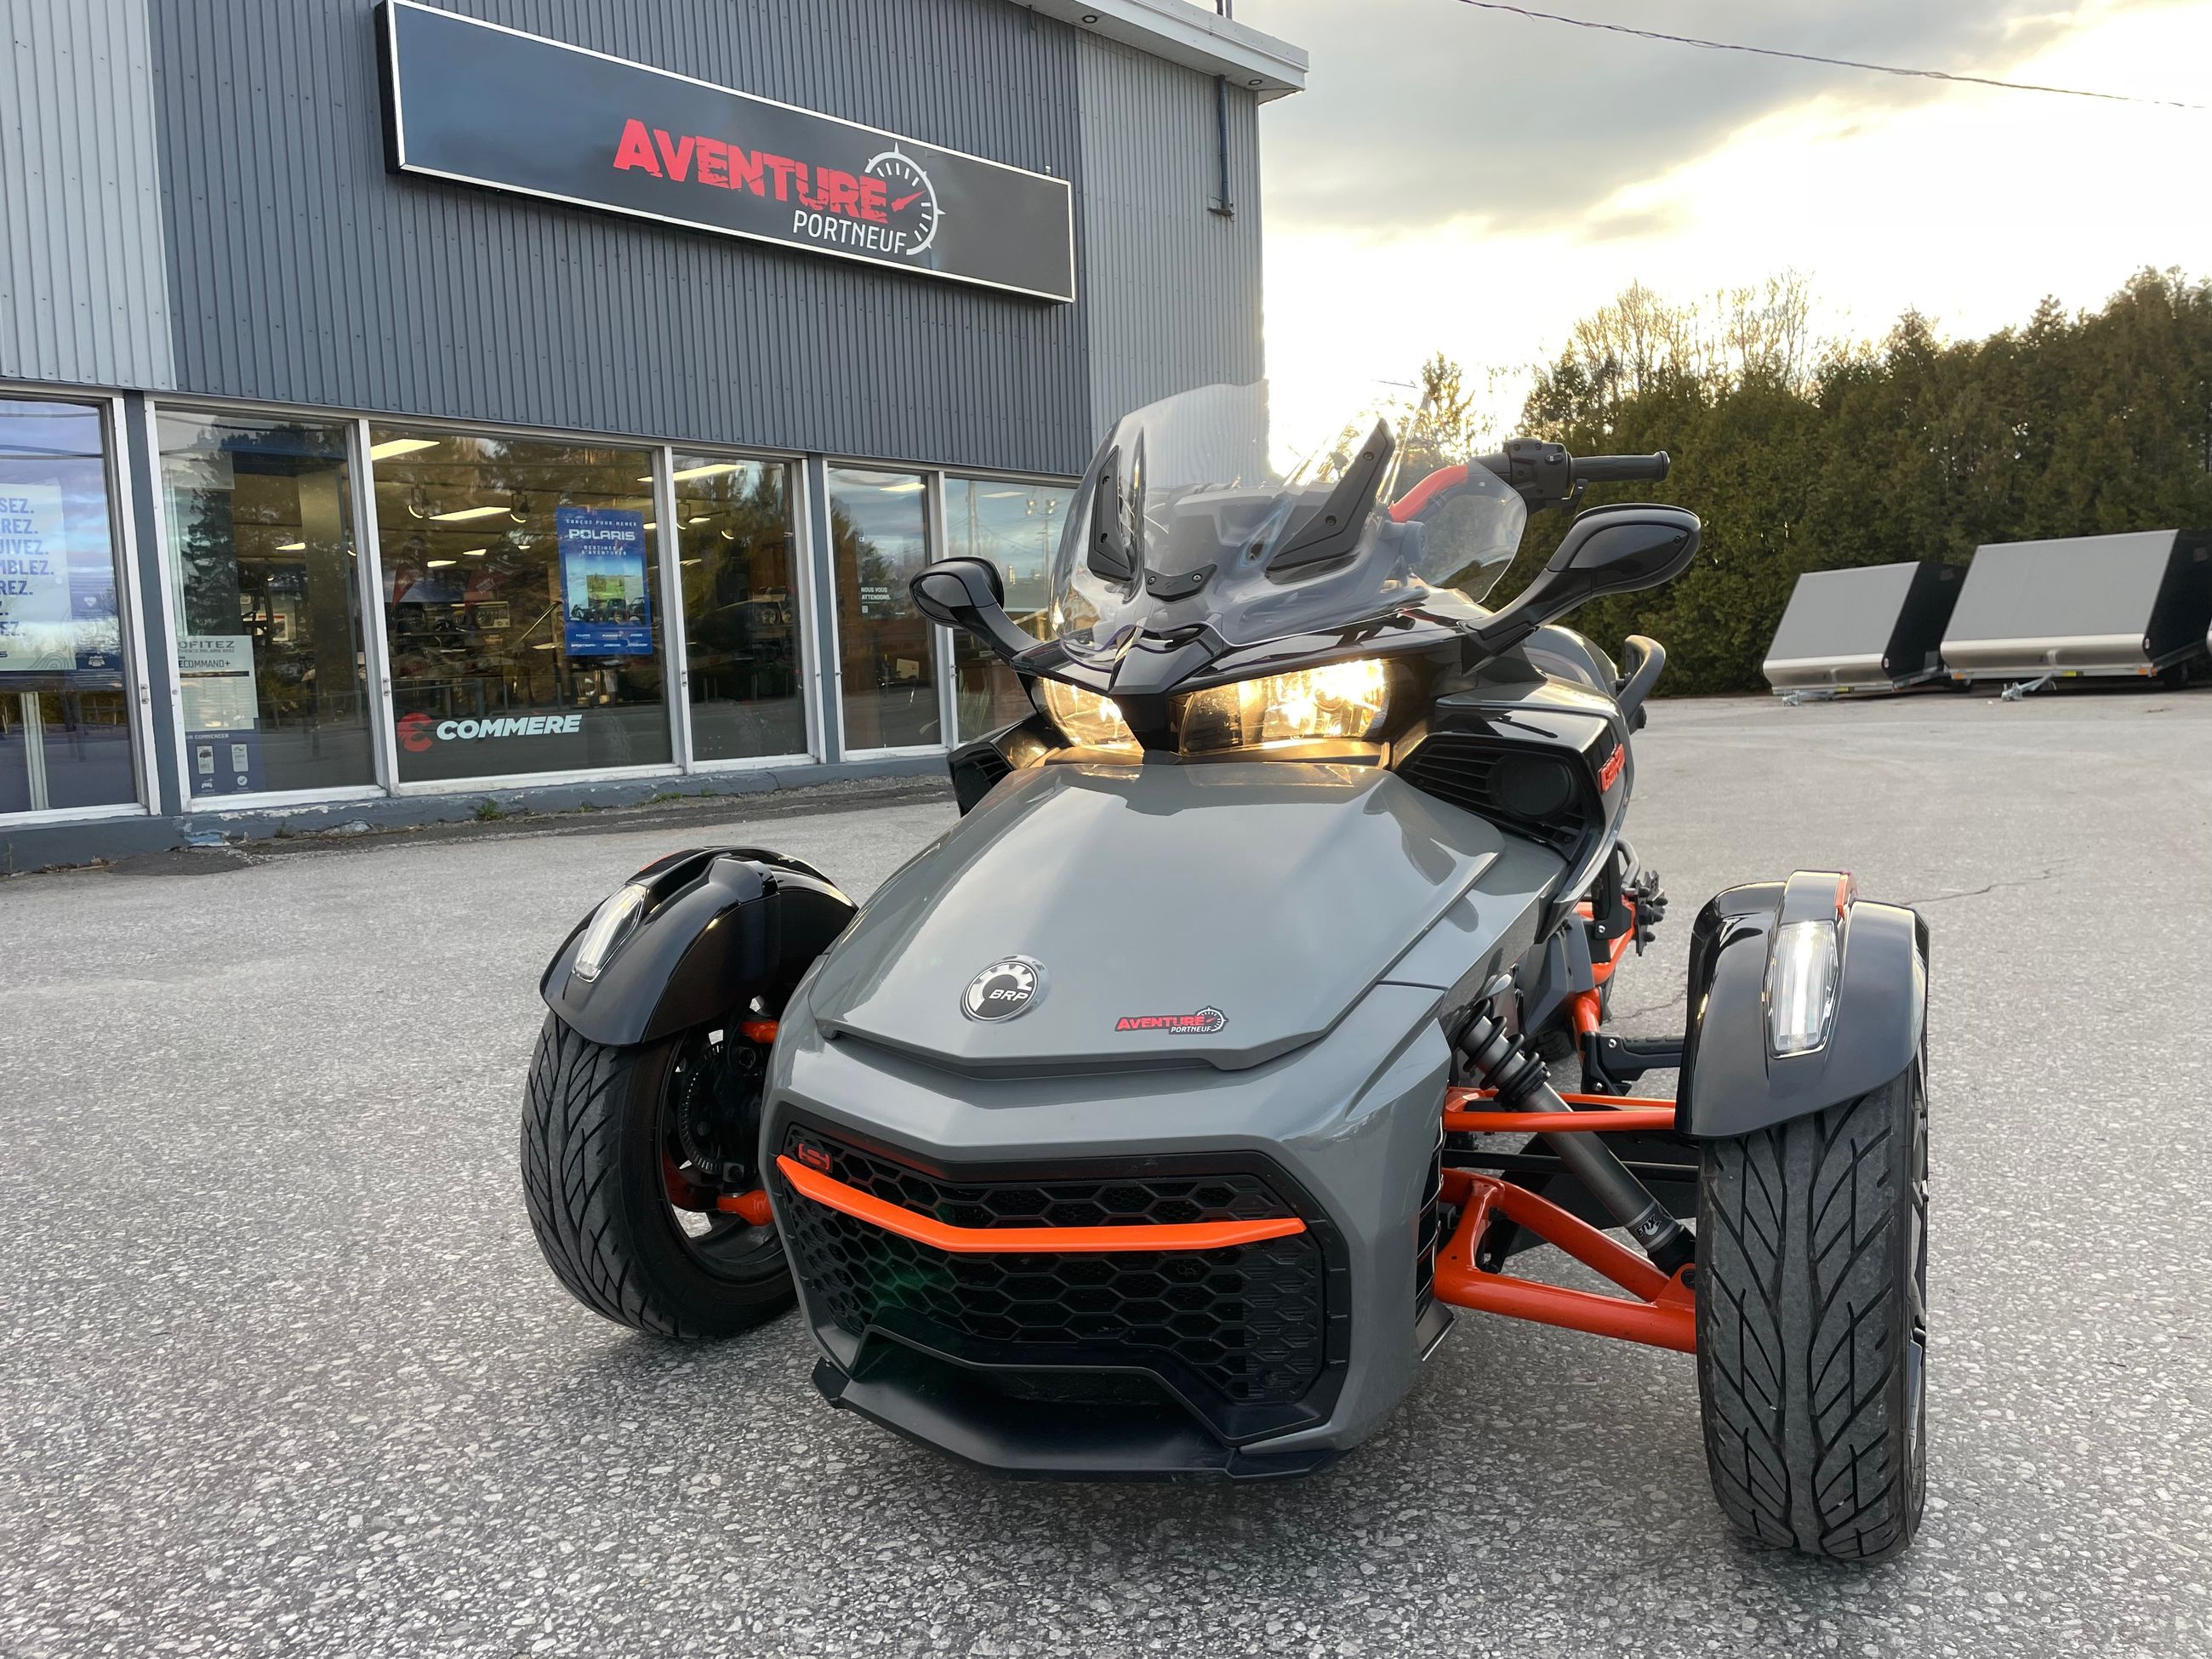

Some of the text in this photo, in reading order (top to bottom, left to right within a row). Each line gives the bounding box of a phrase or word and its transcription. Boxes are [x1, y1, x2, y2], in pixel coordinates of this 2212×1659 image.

[613, 117, 888, 224] AVENTURE
[793, 209, 907, 254] PORTNEUF
[568, 529, 636, 541] POLARIS
[989, 989, 1029, 1001] BRP
[1117, 1016, 1205, 1029] AVENTURE
